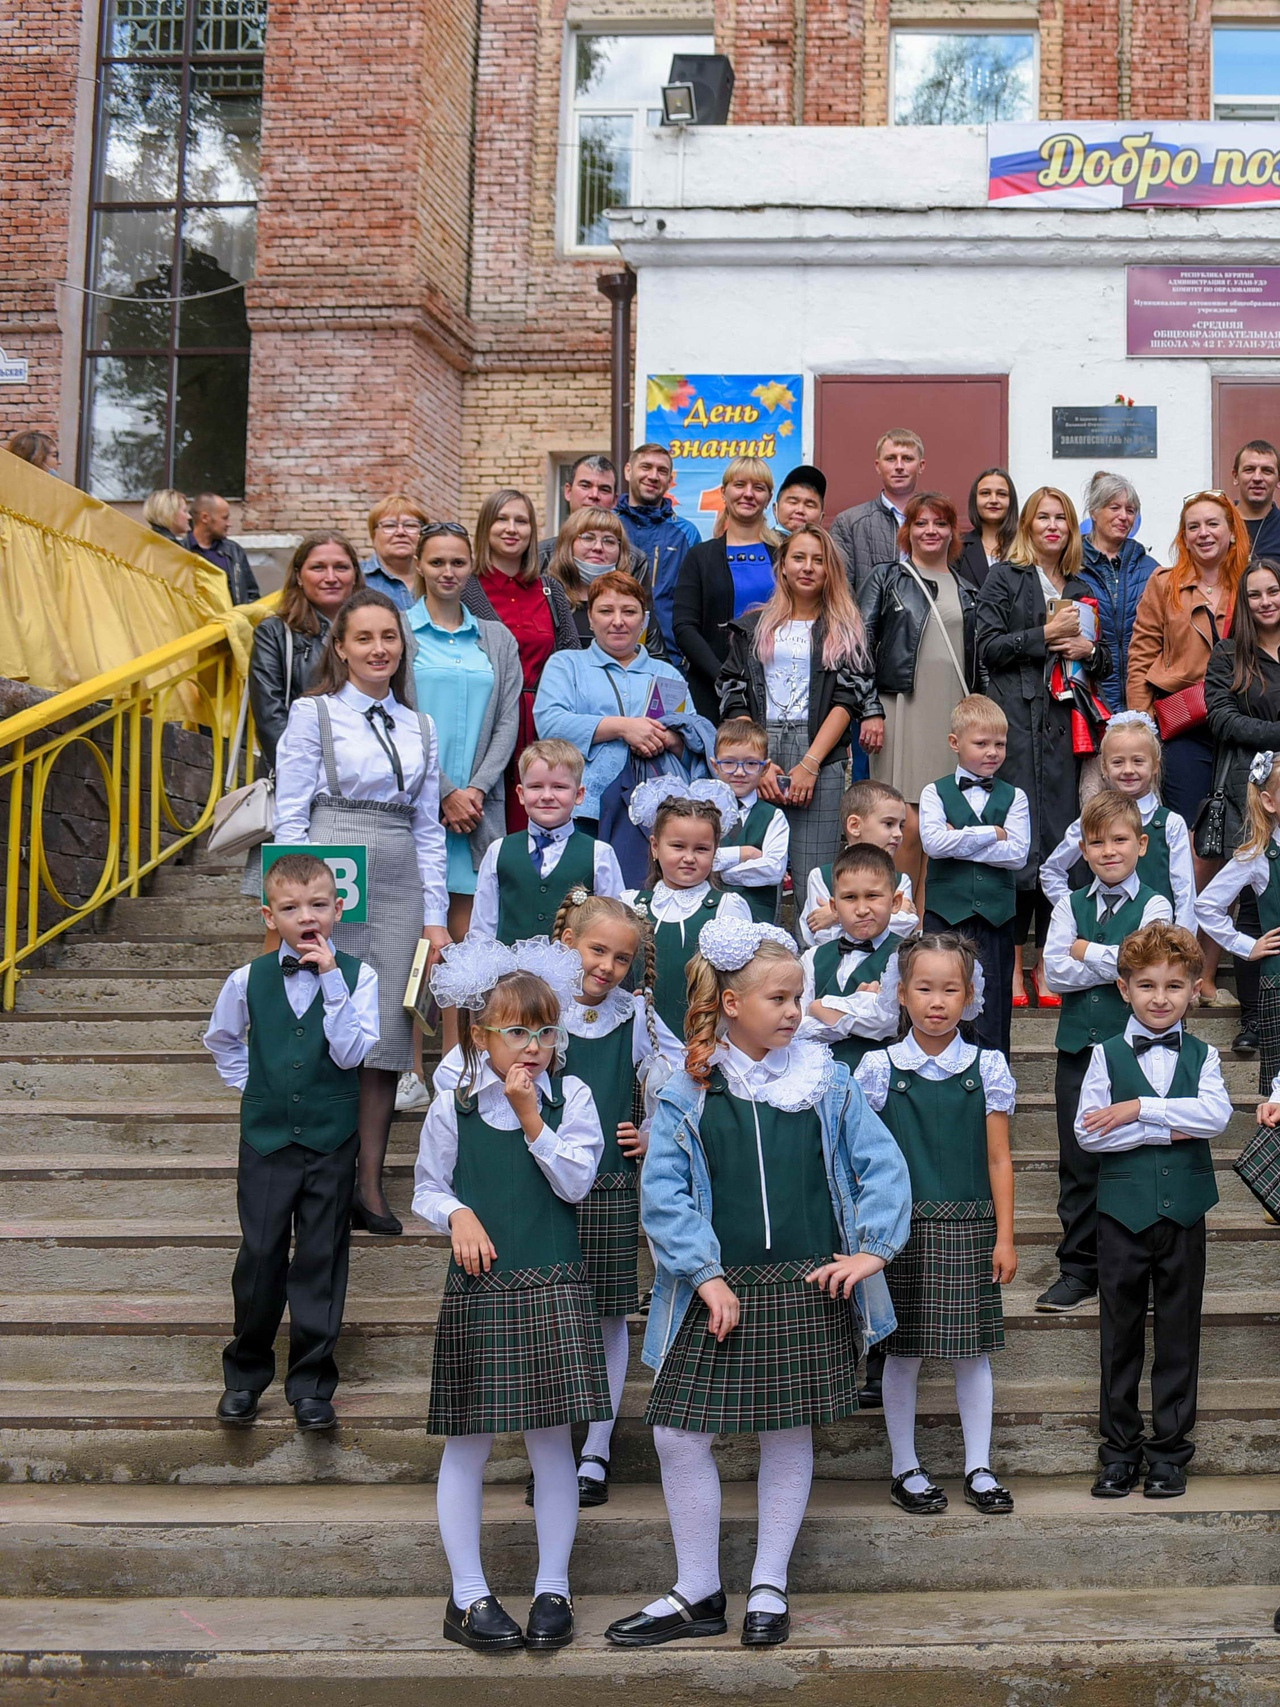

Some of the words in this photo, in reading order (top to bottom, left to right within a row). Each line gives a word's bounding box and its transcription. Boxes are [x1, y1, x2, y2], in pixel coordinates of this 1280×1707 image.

[1037, 131, 1199, 200] Добро
[1134, 299, 1187, 307] Муниципальное
[1192, 321, 1244, 330] «СРЕДНЯЯ
[1150, 340, 1188, 348] ШКОЛА
[1190, 340, 1201, 348] №
[1203, 340, 1215, 348] 42
[683, 397, 760, 429] День
[669, 433, 776, 459] знаний
